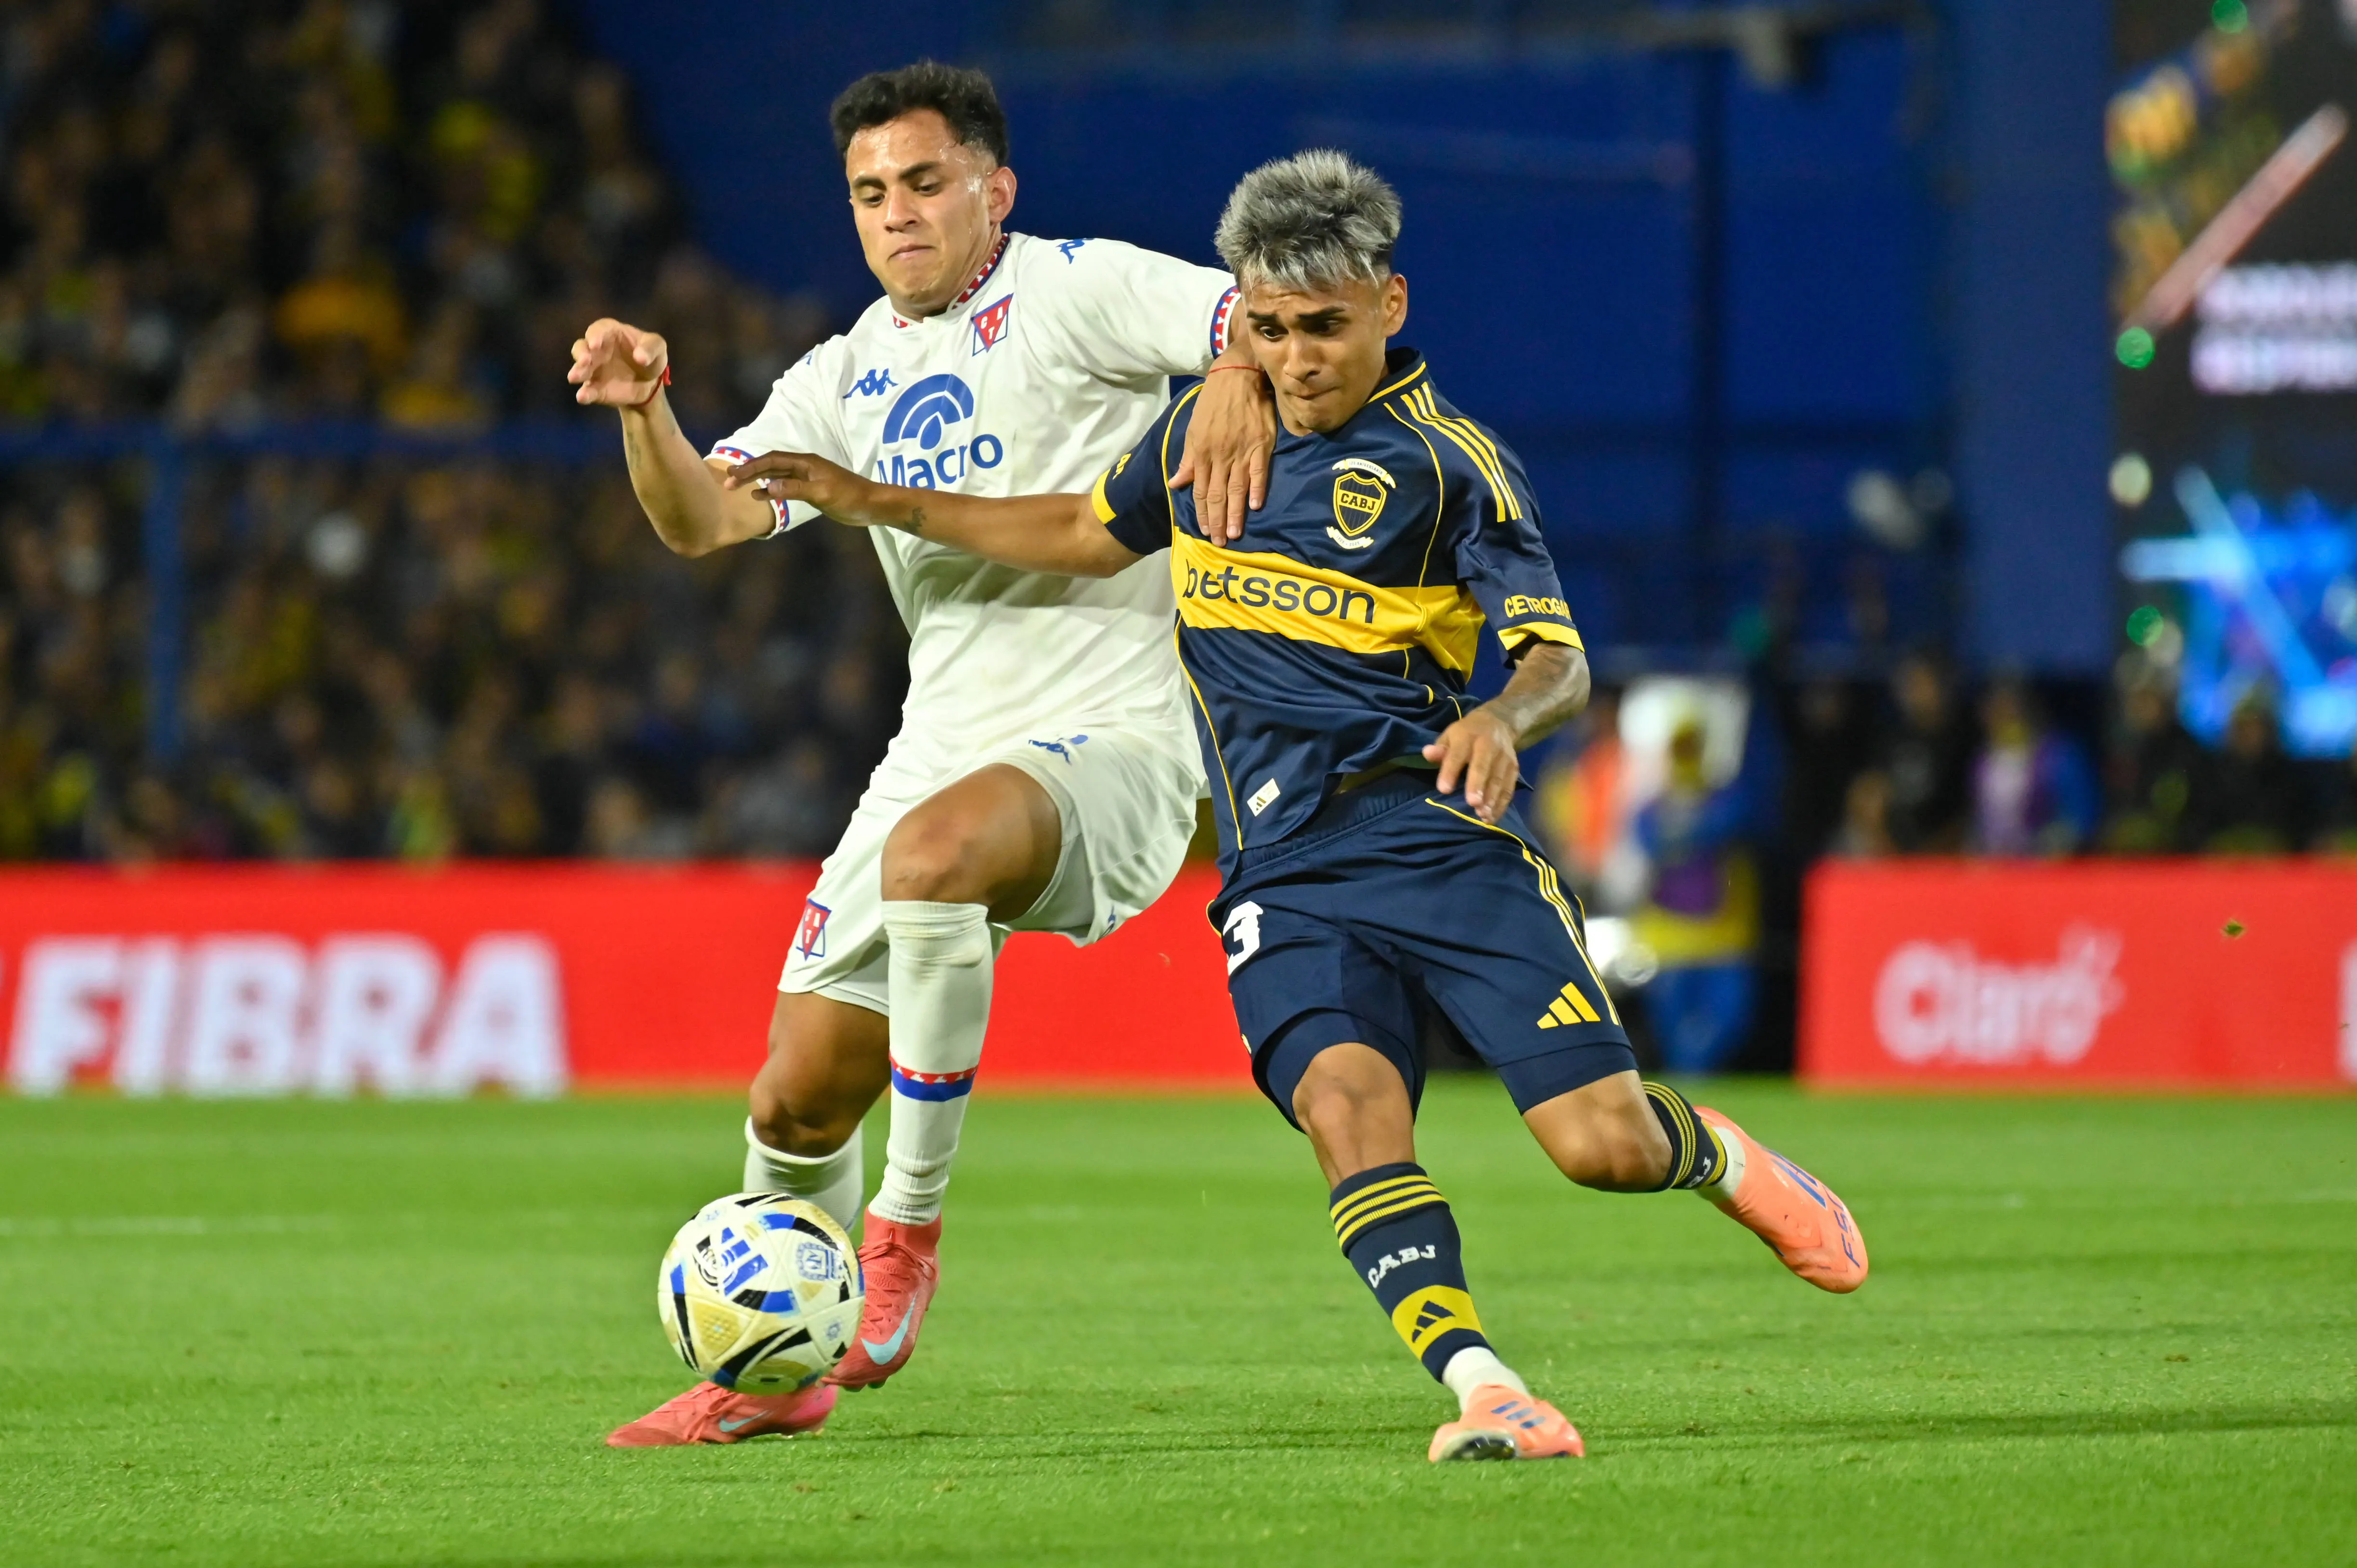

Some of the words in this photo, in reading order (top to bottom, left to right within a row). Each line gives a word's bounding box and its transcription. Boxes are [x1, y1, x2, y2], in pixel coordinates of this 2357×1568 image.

[877, 434, 1003, 490] Macro
[1341, 493, 1376, 510] CABJ
[1182, 558, 1375, 623] betsson
[1223, 901, 1263, 977] 3
[9, 934, 572, 1096] FIBRA
[1874, 928, 2107, 1065] Claro
[1368, 1244, 1436, 1289] CABJ
